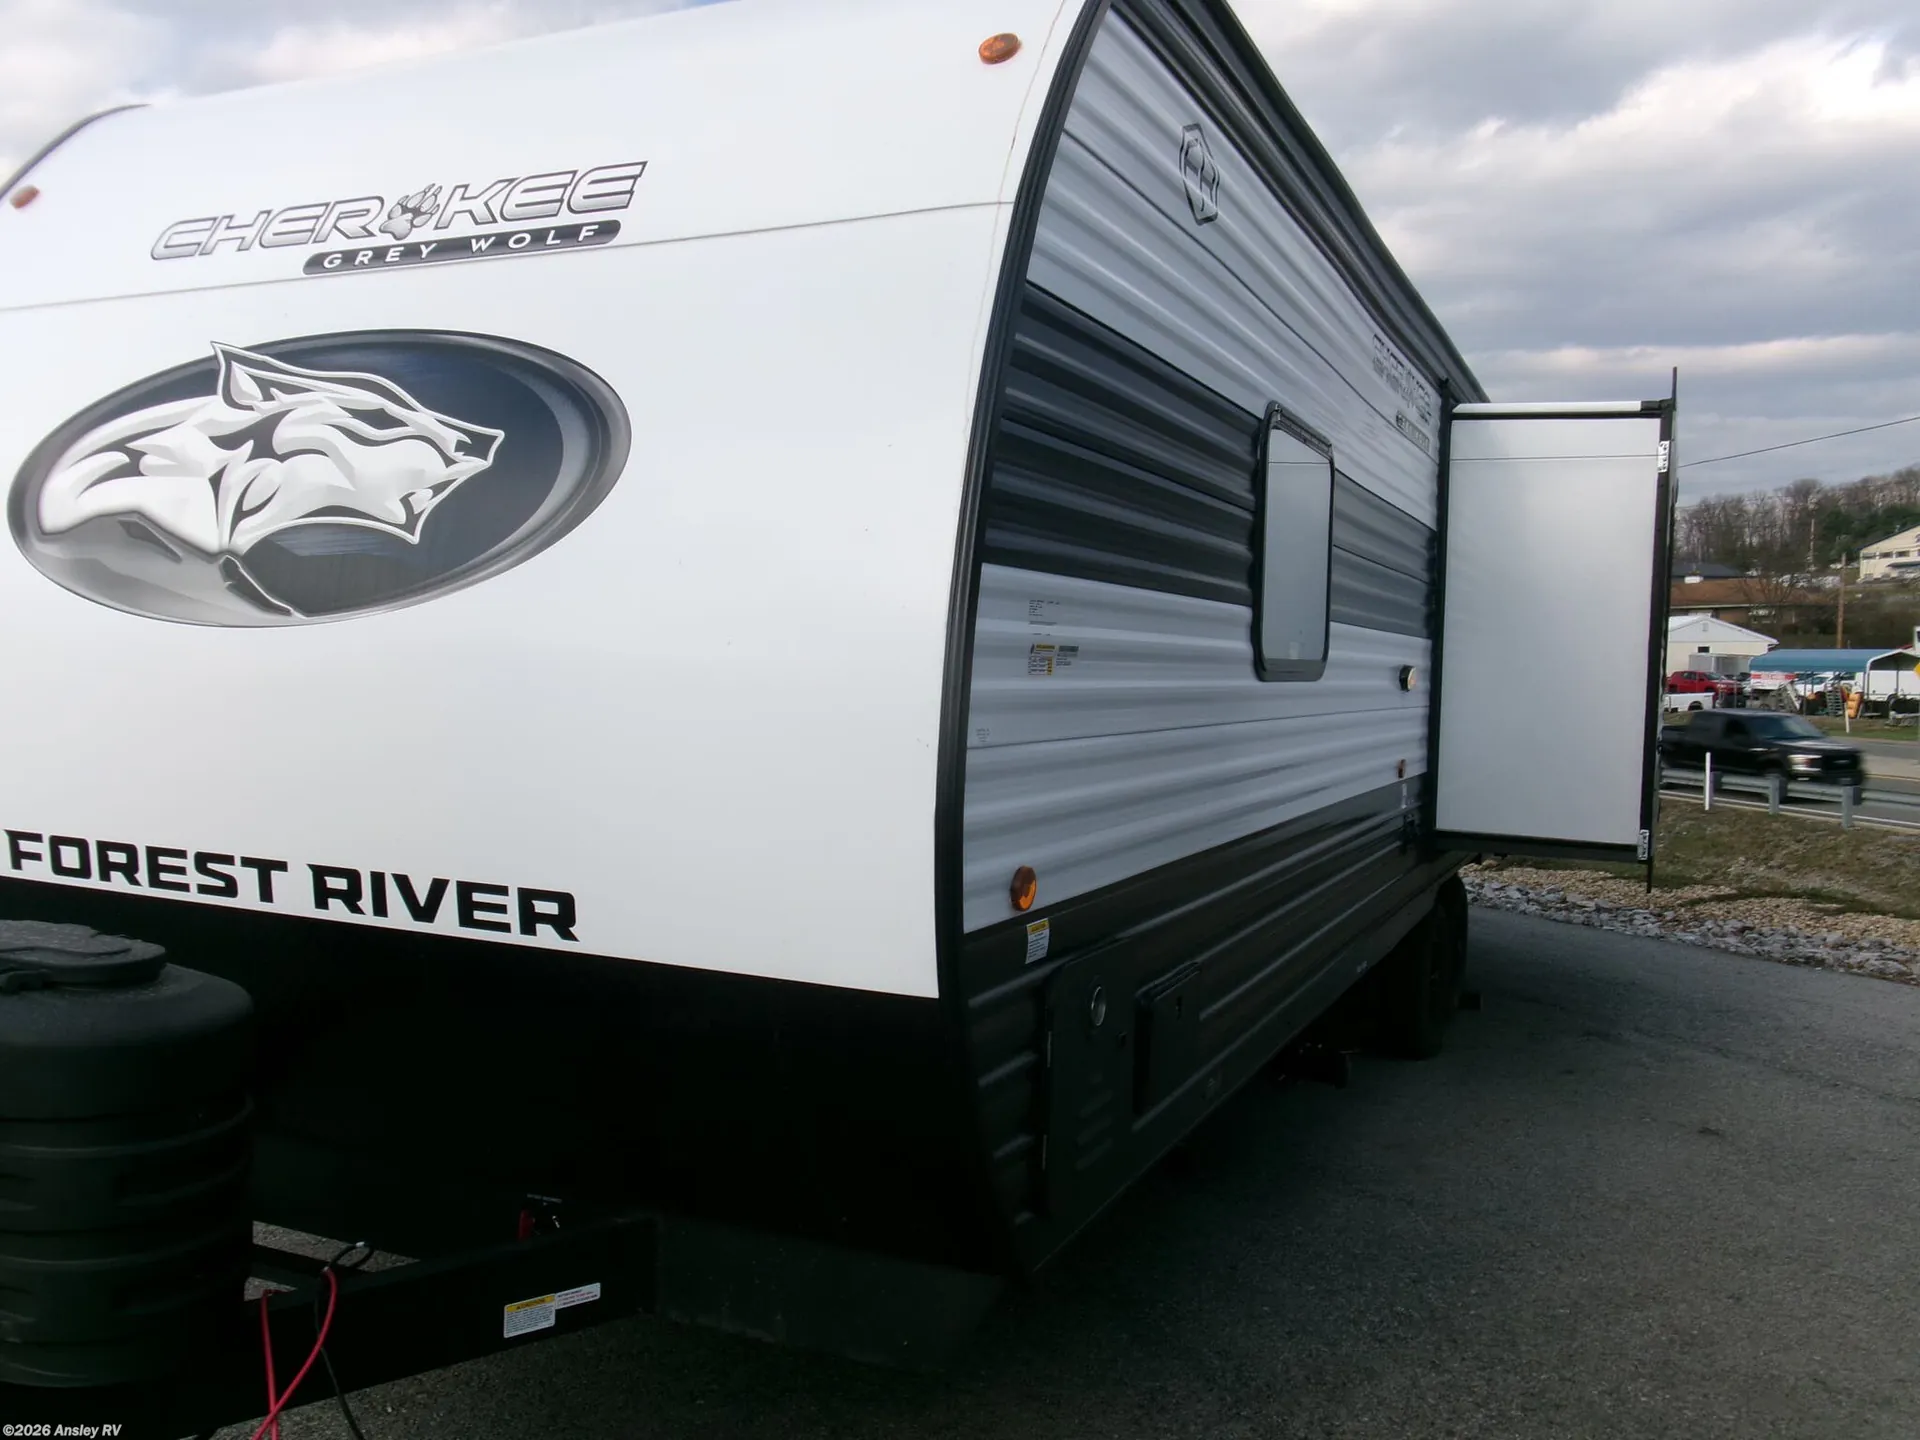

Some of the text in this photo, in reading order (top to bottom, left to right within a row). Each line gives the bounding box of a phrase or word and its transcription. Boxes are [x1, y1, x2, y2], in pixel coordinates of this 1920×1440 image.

[322, 224, 600, 270] GREY WOLF
[3, 828, 580, 942] FOREST RIVER
